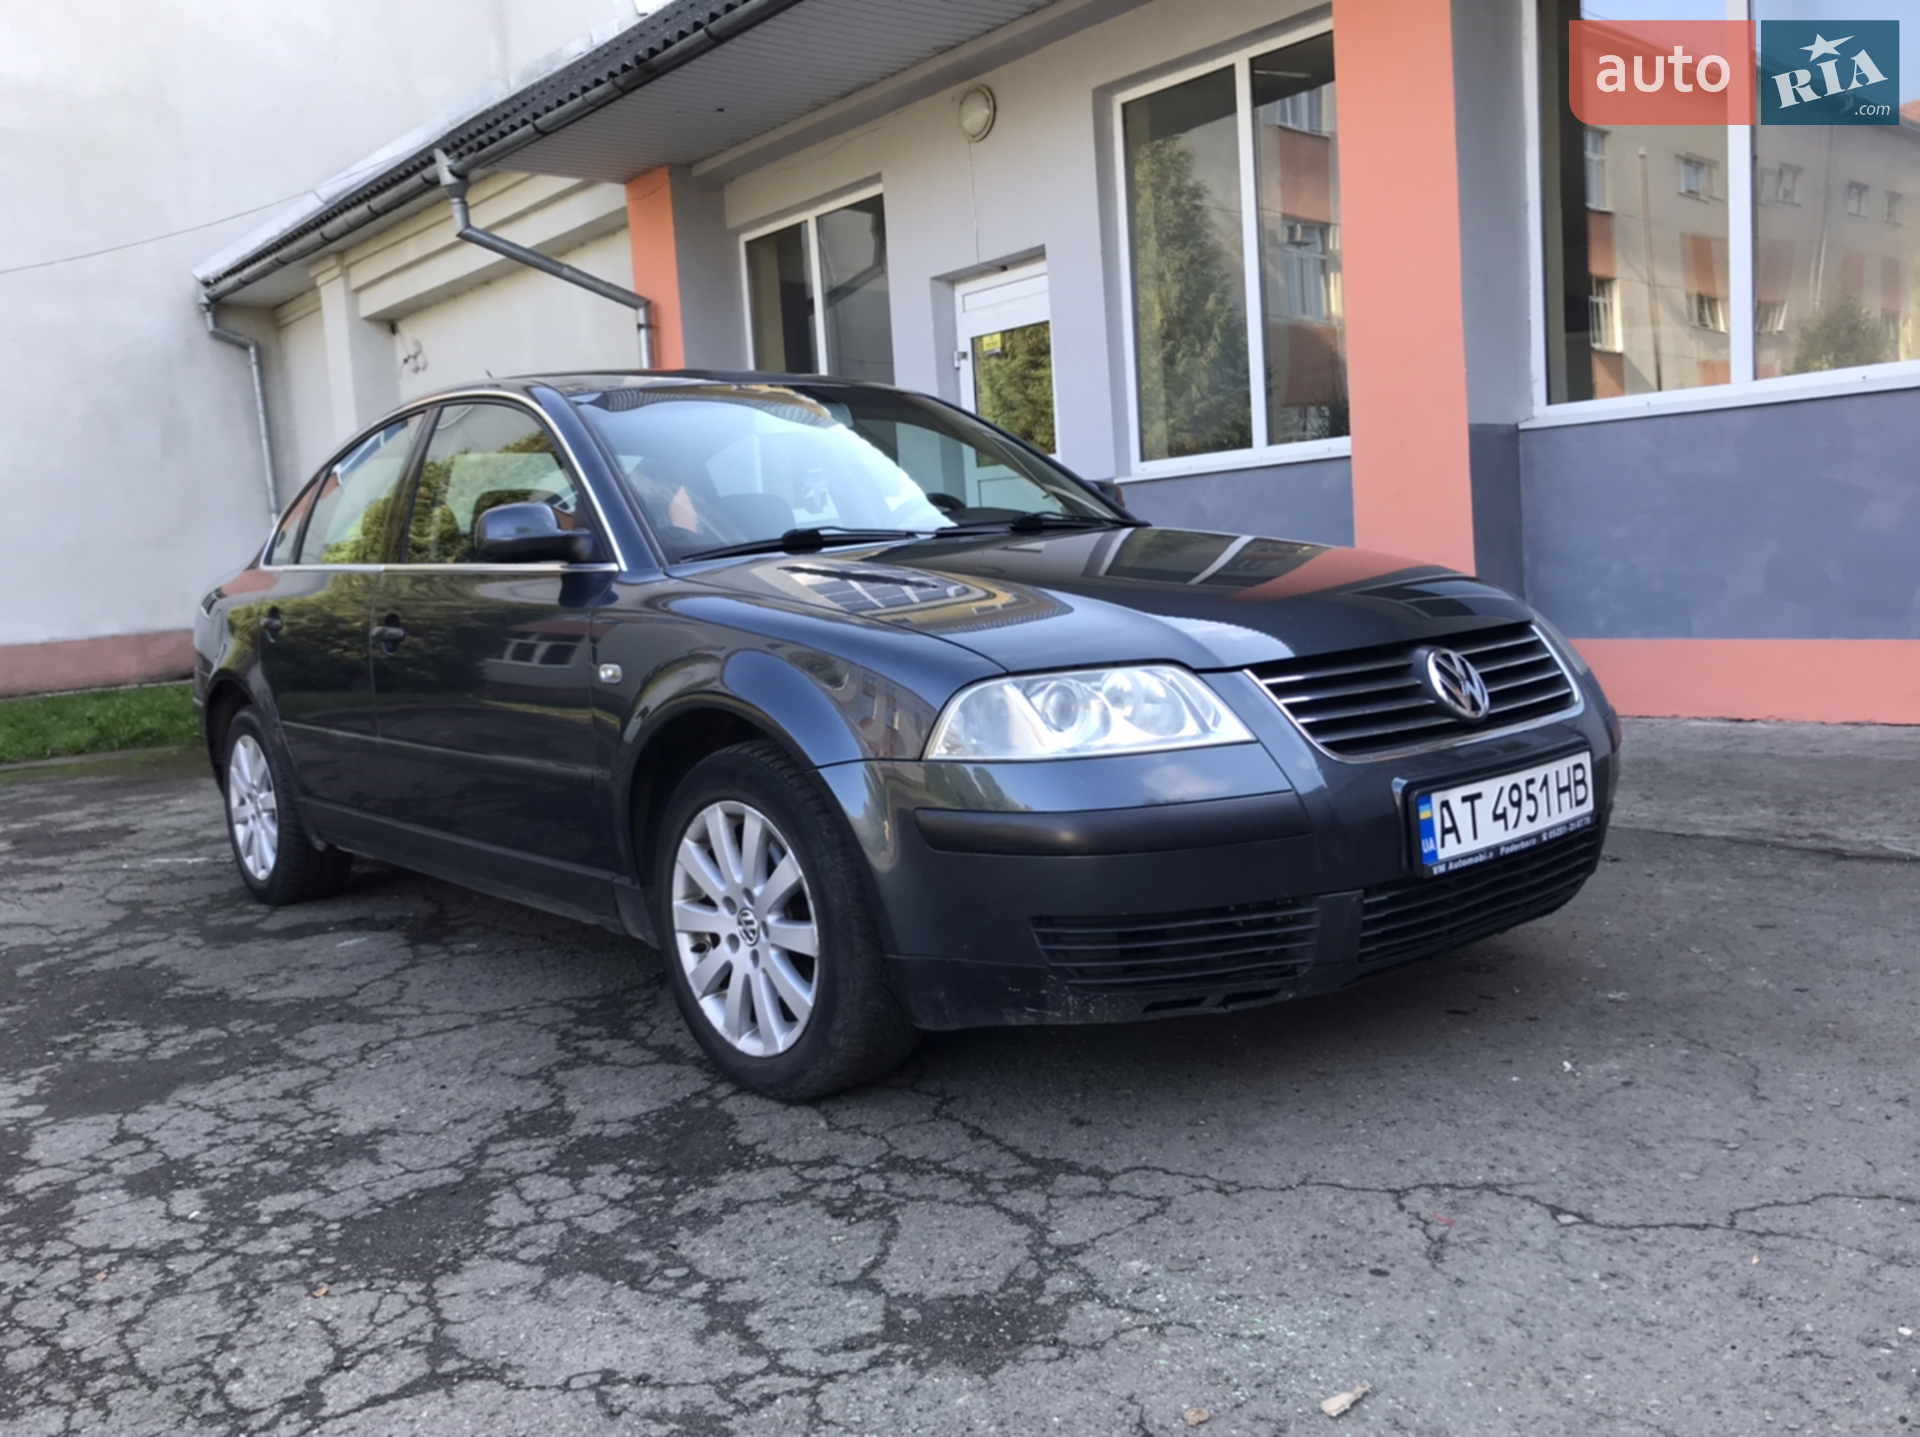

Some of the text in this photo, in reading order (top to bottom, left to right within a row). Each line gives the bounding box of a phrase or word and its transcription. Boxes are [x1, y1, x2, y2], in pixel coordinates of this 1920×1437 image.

[1440, 762, 1588, 849] AT 4951 HB
[1421, 837, 1436, 853] UA
